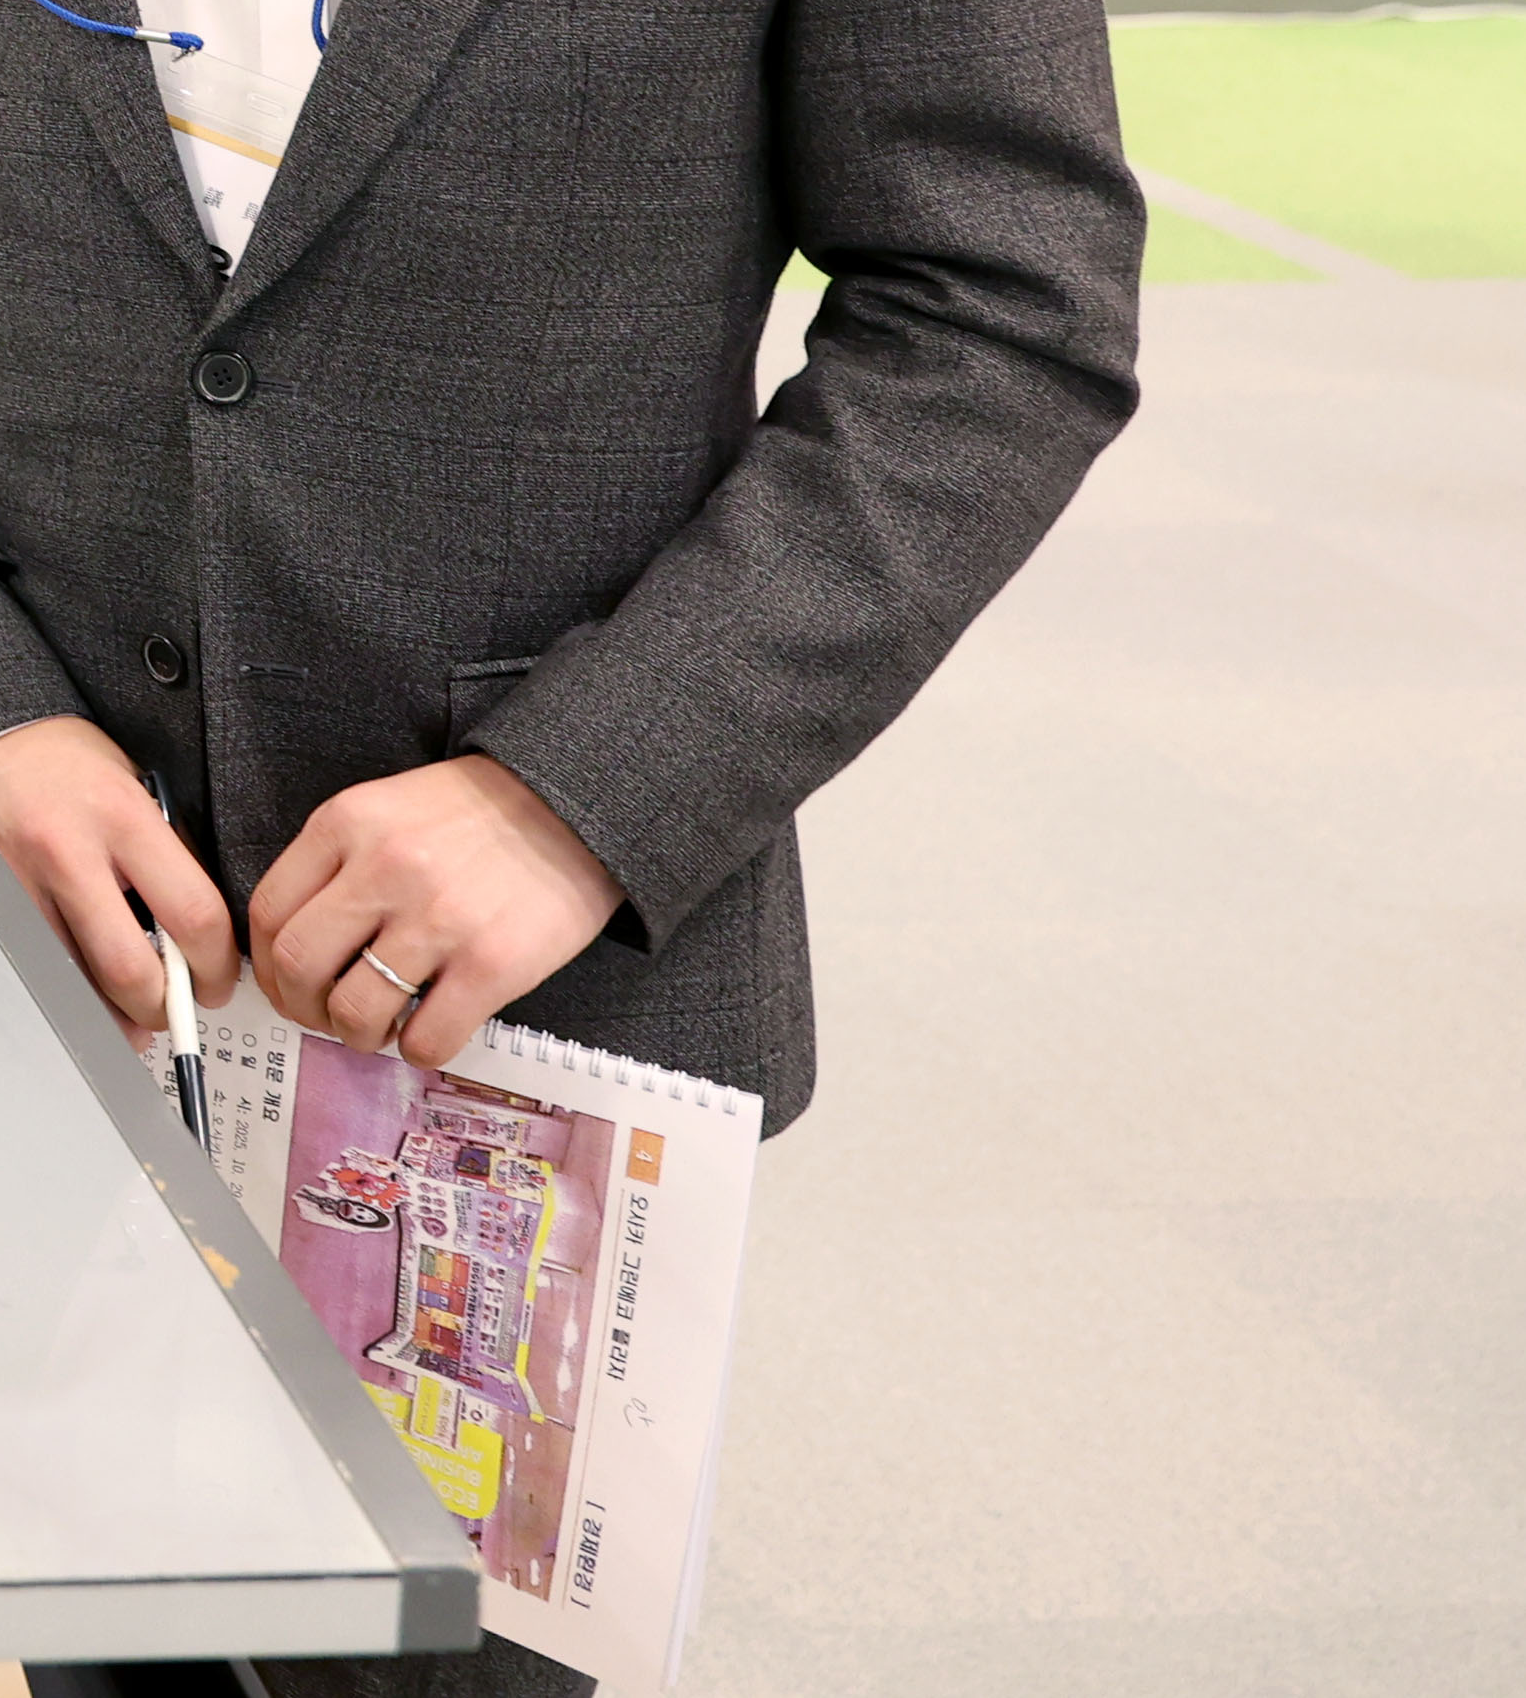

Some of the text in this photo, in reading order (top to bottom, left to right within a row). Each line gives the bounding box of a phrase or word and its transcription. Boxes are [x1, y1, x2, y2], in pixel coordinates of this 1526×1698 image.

[216, 1047, 234, 1064] 장
[240, 1055, 257, 1070] 일
[262, 1051, 287, 1122] 방문 개요
[232, 1119, 250, 1152] 2025.
[229, 1159, 247, 1176] 10.
[605, 1147, 655, 1383] 4 오사카 그린에코 플라자
[573, 1517, 603, 1594] 경제환경
